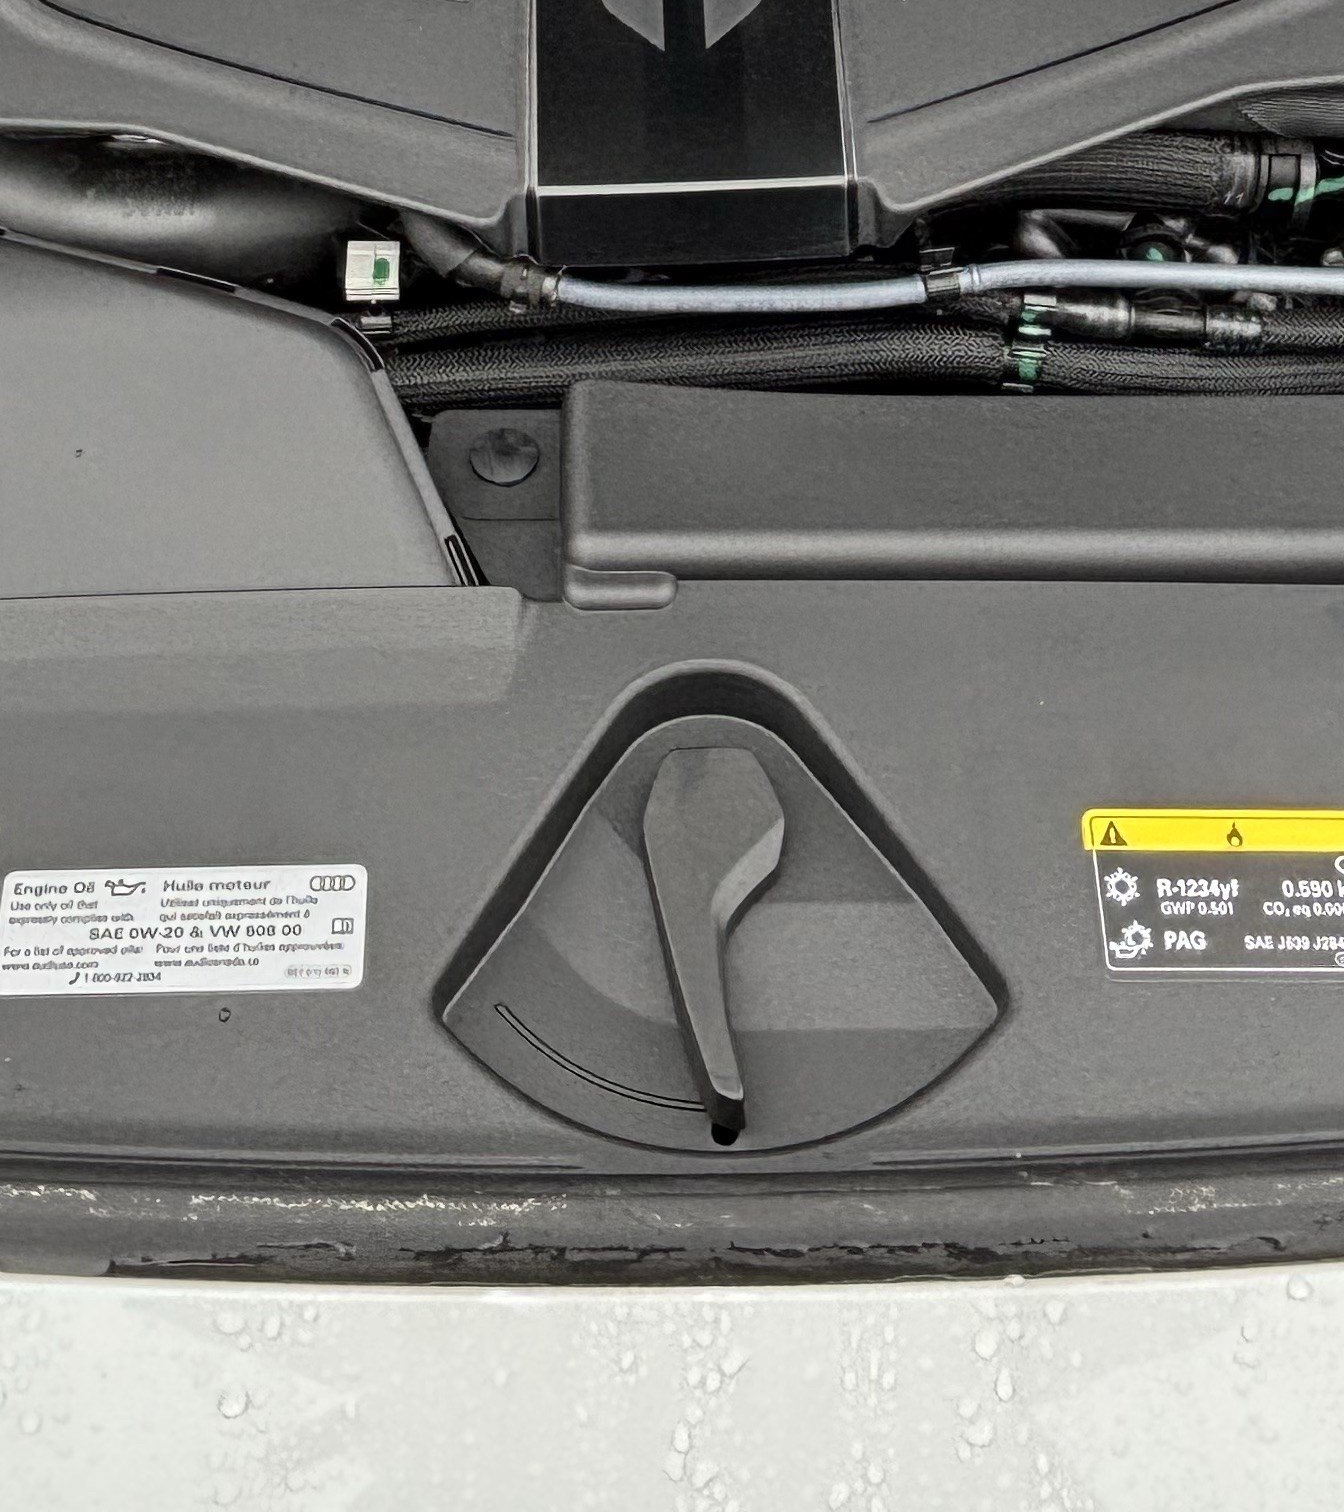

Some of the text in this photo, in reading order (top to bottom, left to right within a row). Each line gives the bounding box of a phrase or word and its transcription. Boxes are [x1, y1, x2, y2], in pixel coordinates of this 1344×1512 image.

[14, 882, 68, 897] Engine
[163, 879, 271, 892] Huile moteur
[1156, 878, 1239, 900] R-1234yf
[1160, 900, 1195, 915] GWP
[89, 927, 124, 940] SAE
[129, 926, 184, 939] 0W-20
[189, 925, 203, 938] &
[210, 925, 240, 937] VW
[282, 924, 303, 936] 00
[1164, 930, 1208, 950] PAG
[1243, 934, 1275, 950] SAE
